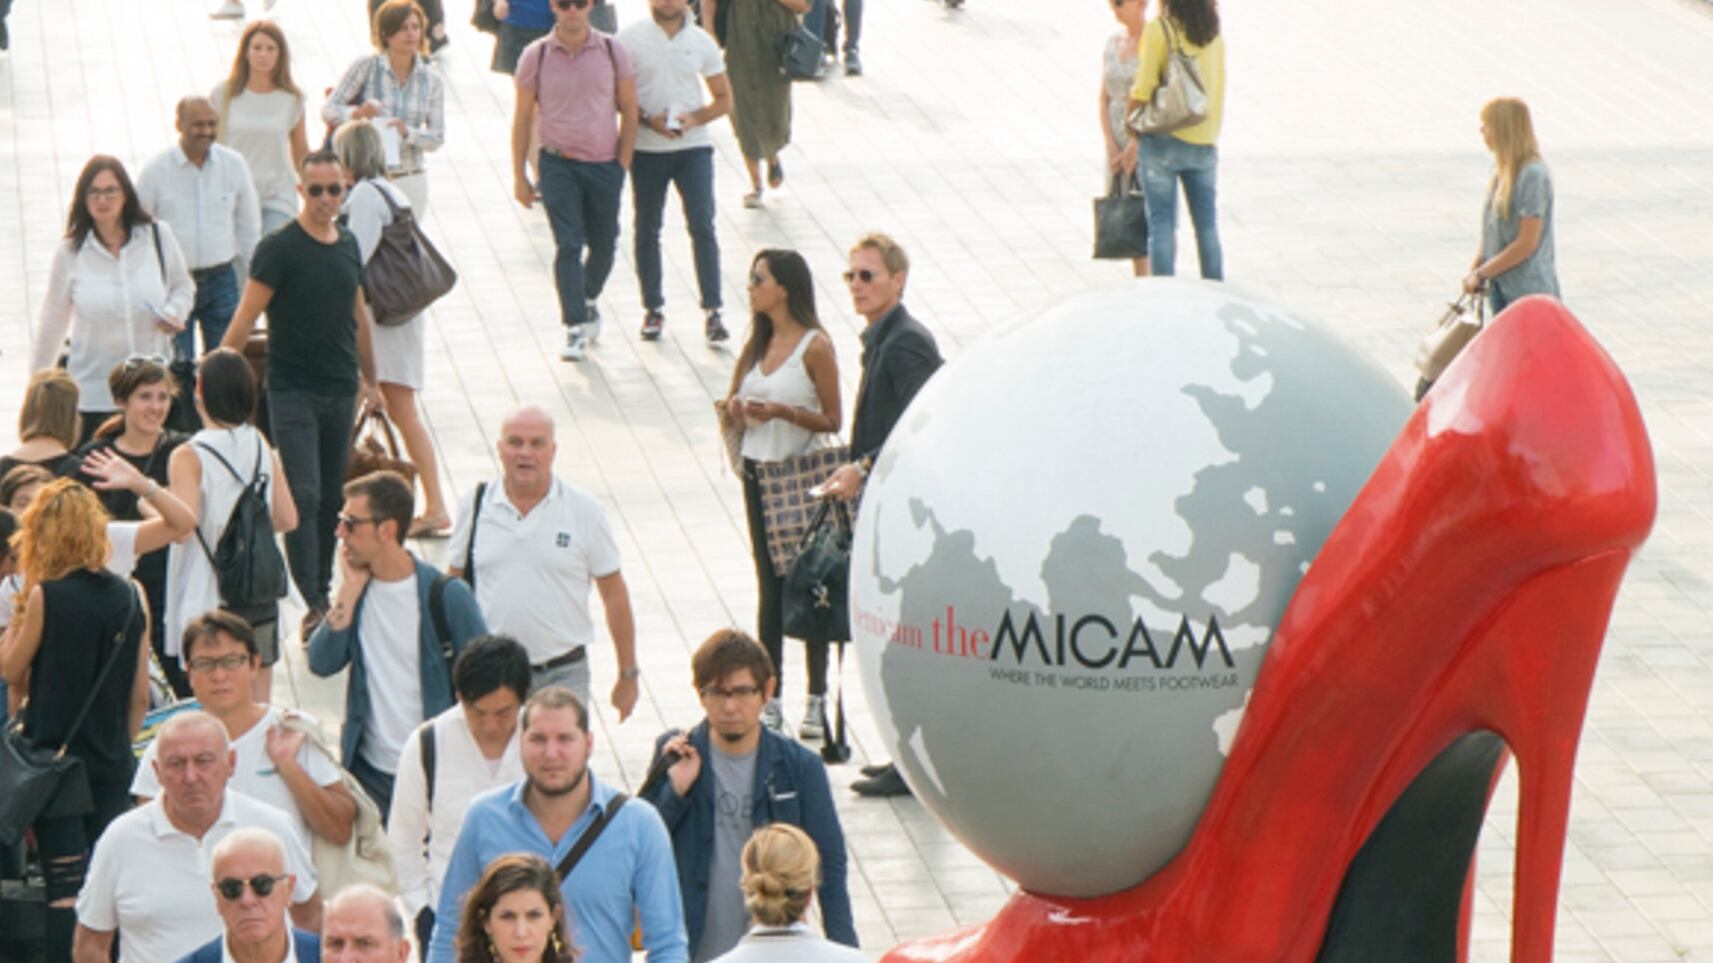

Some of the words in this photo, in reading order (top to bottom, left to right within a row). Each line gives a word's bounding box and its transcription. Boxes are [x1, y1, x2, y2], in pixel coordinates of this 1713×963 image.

[989, 667, 1031, 687] WHERE
[1035, 672, 1057, 688] THE
[1062, 674, 1110, 691] WORLD
[1113, 676, 1157, 693] MEETS
[1159, 673, 1239, 690] FOOTWEAR
